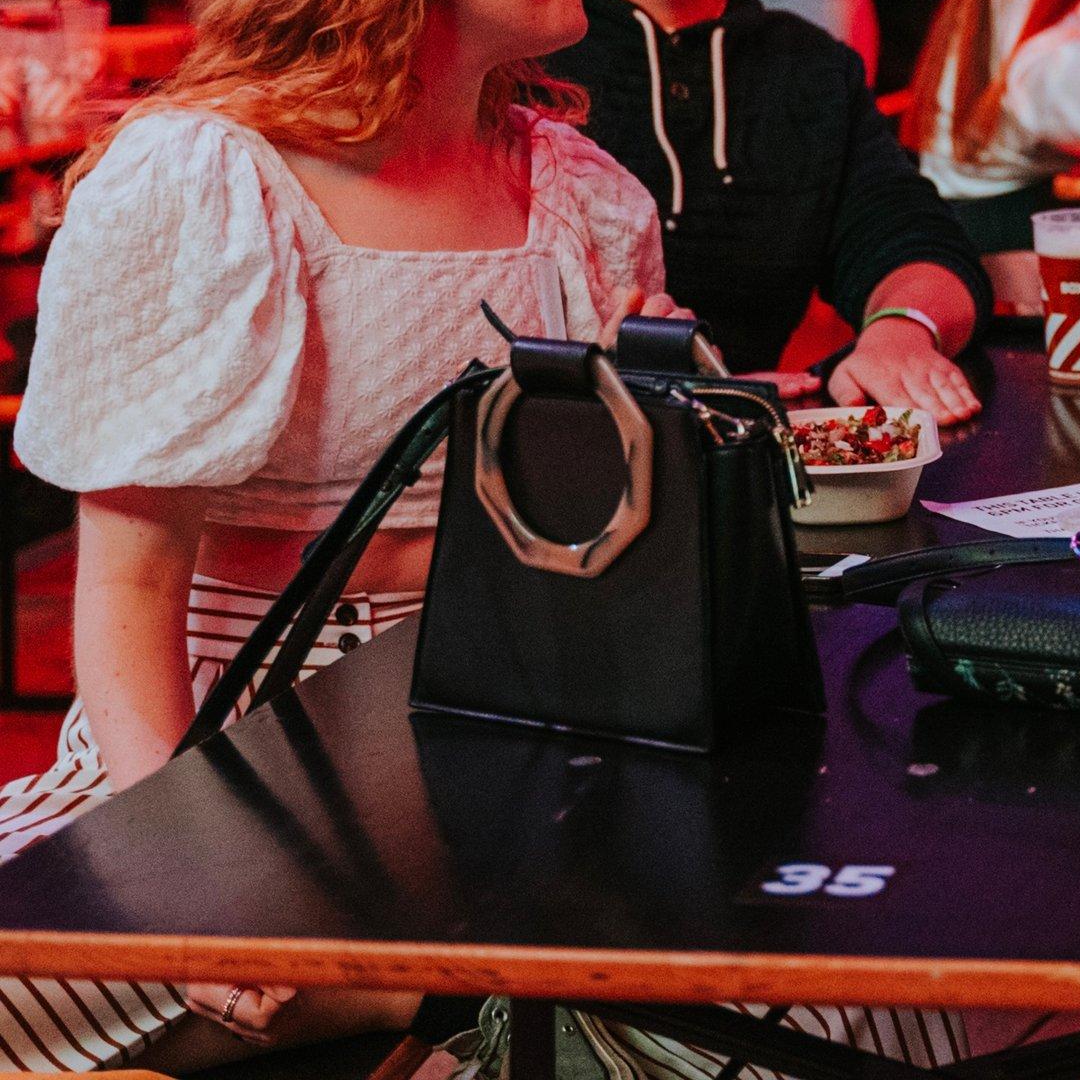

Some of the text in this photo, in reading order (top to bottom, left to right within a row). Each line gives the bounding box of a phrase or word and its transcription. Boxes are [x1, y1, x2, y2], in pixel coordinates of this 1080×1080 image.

[971, 501, 1018, 512] THIS
[1015, 493, 1073, 506] TABLE
[1030, 500, 1071, 511] FOR
[761, 864, 896, 896] 35
